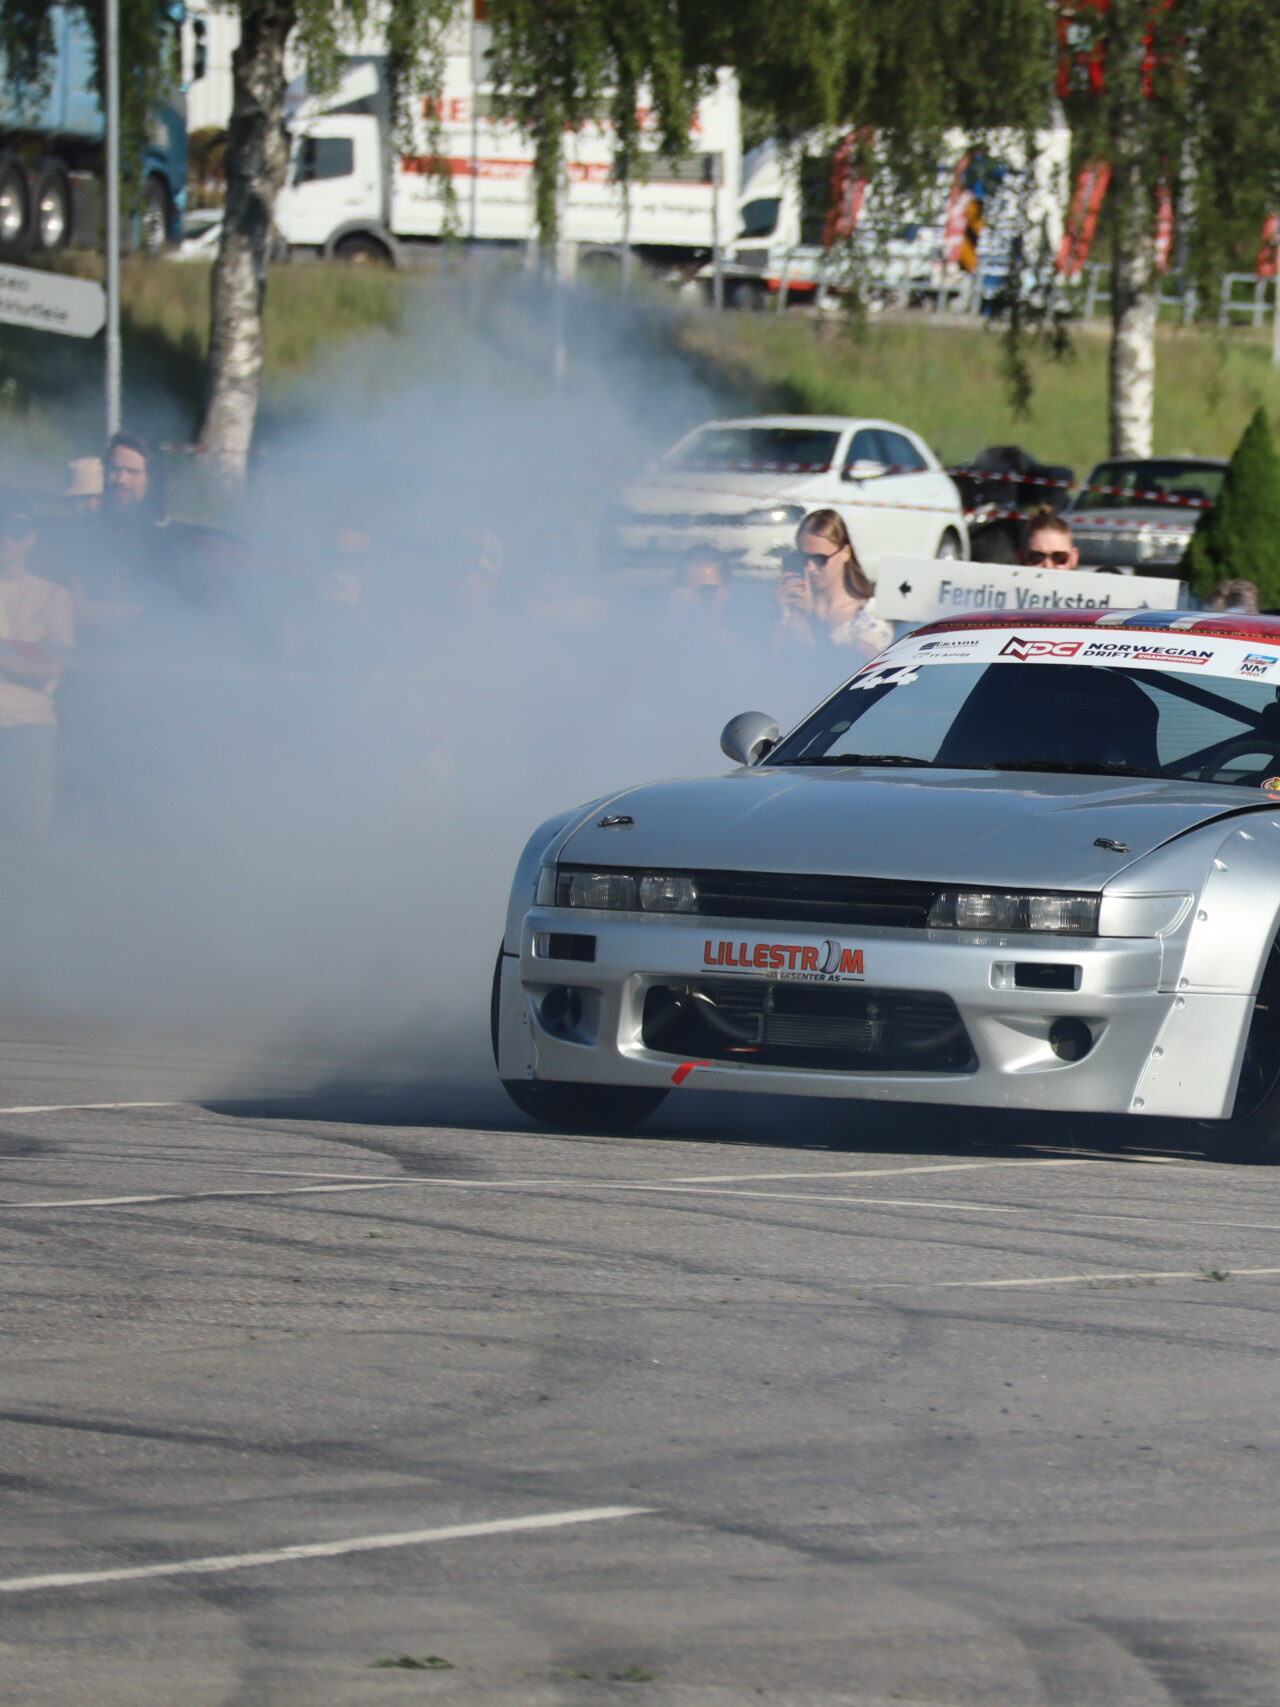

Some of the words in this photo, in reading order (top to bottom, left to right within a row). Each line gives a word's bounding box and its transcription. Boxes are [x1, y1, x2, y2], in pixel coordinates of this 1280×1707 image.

[938, 580, 1007, 608] Ferdig
[1015, 586, 1111, 609] Verksted
[1003, 641, 1077, 655] NDC
[1088, 643, 1214, 658] NORWEGIAN
[1083, 650, 1133, 658] DRIFT
[1137, 654, 1204, 663] CHAMPIONSHIP
[1240, 663, 1268, 674] NM
